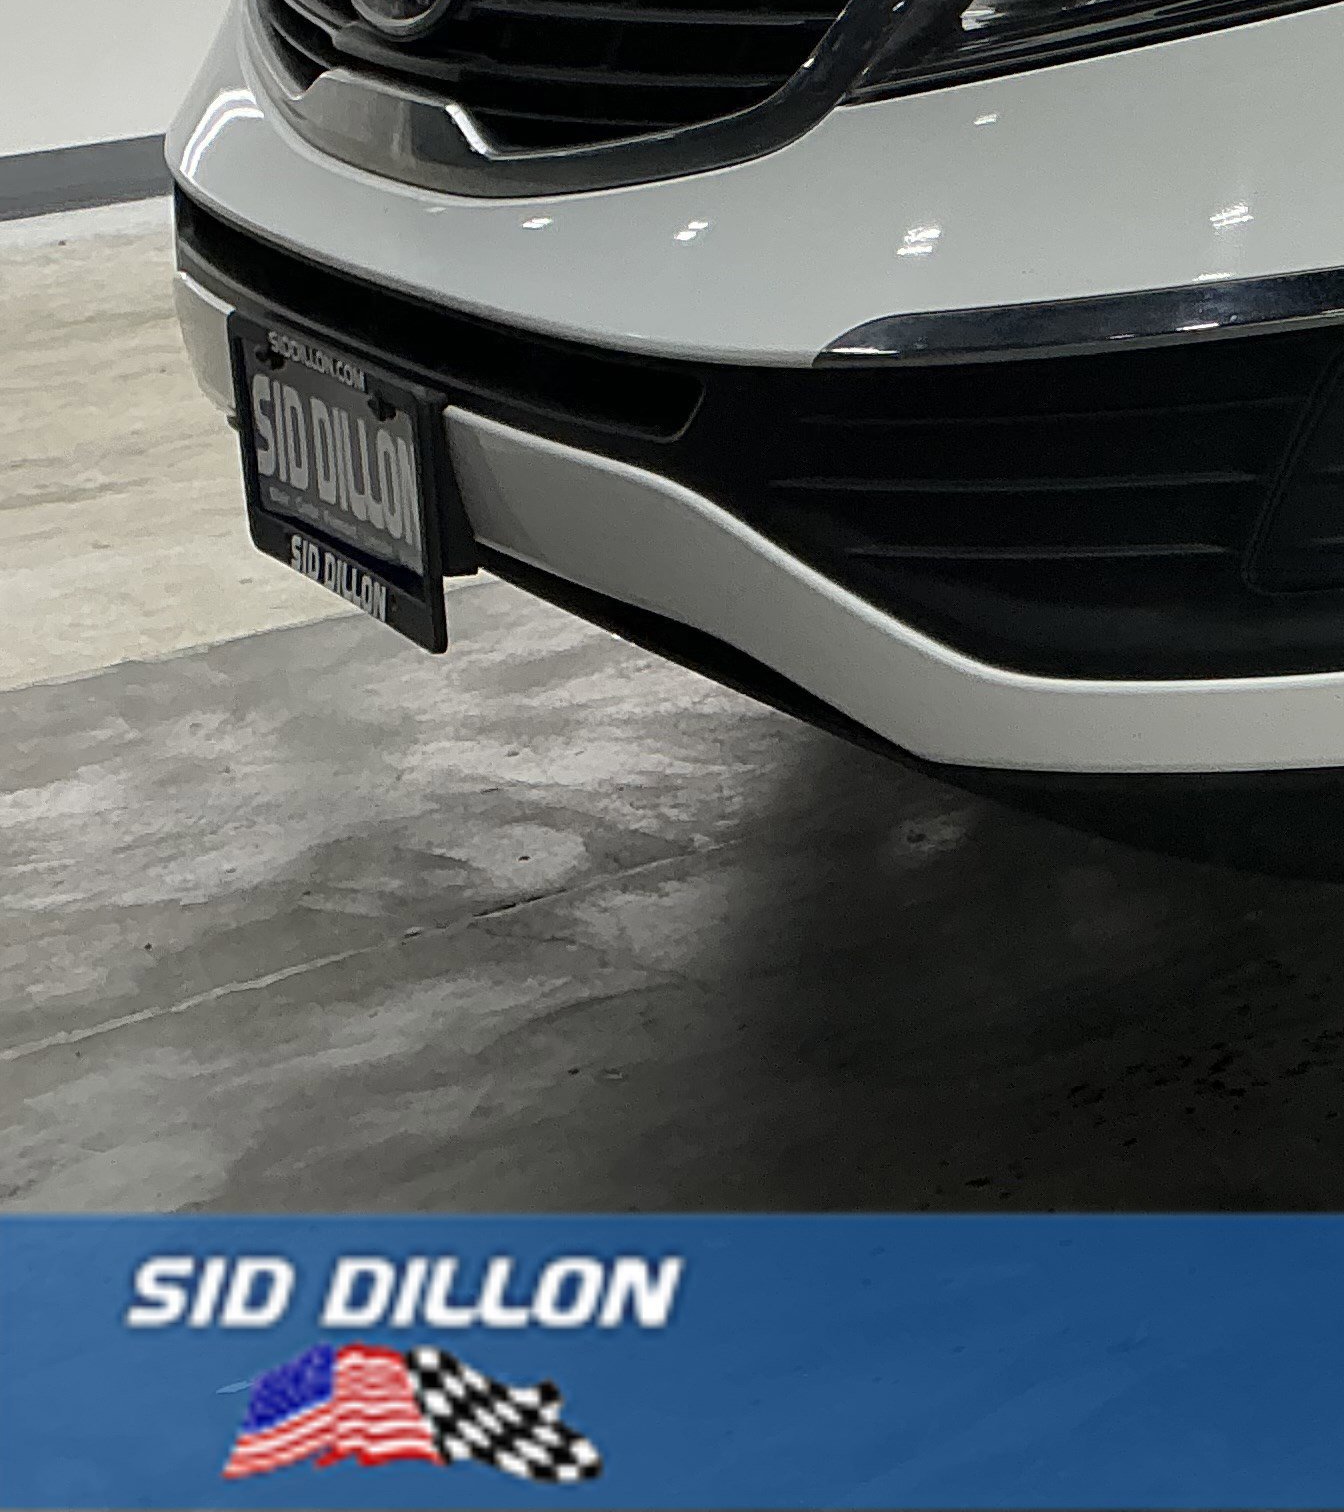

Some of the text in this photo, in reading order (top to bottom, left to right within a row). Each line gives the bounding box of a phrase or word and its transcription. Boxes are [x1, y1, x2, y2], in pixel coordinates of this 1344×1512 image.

[252, 373, 309, 490] SID
[310, 396, 423, 552] DILLON
[291, 533, 387, 623] SID DILLON
